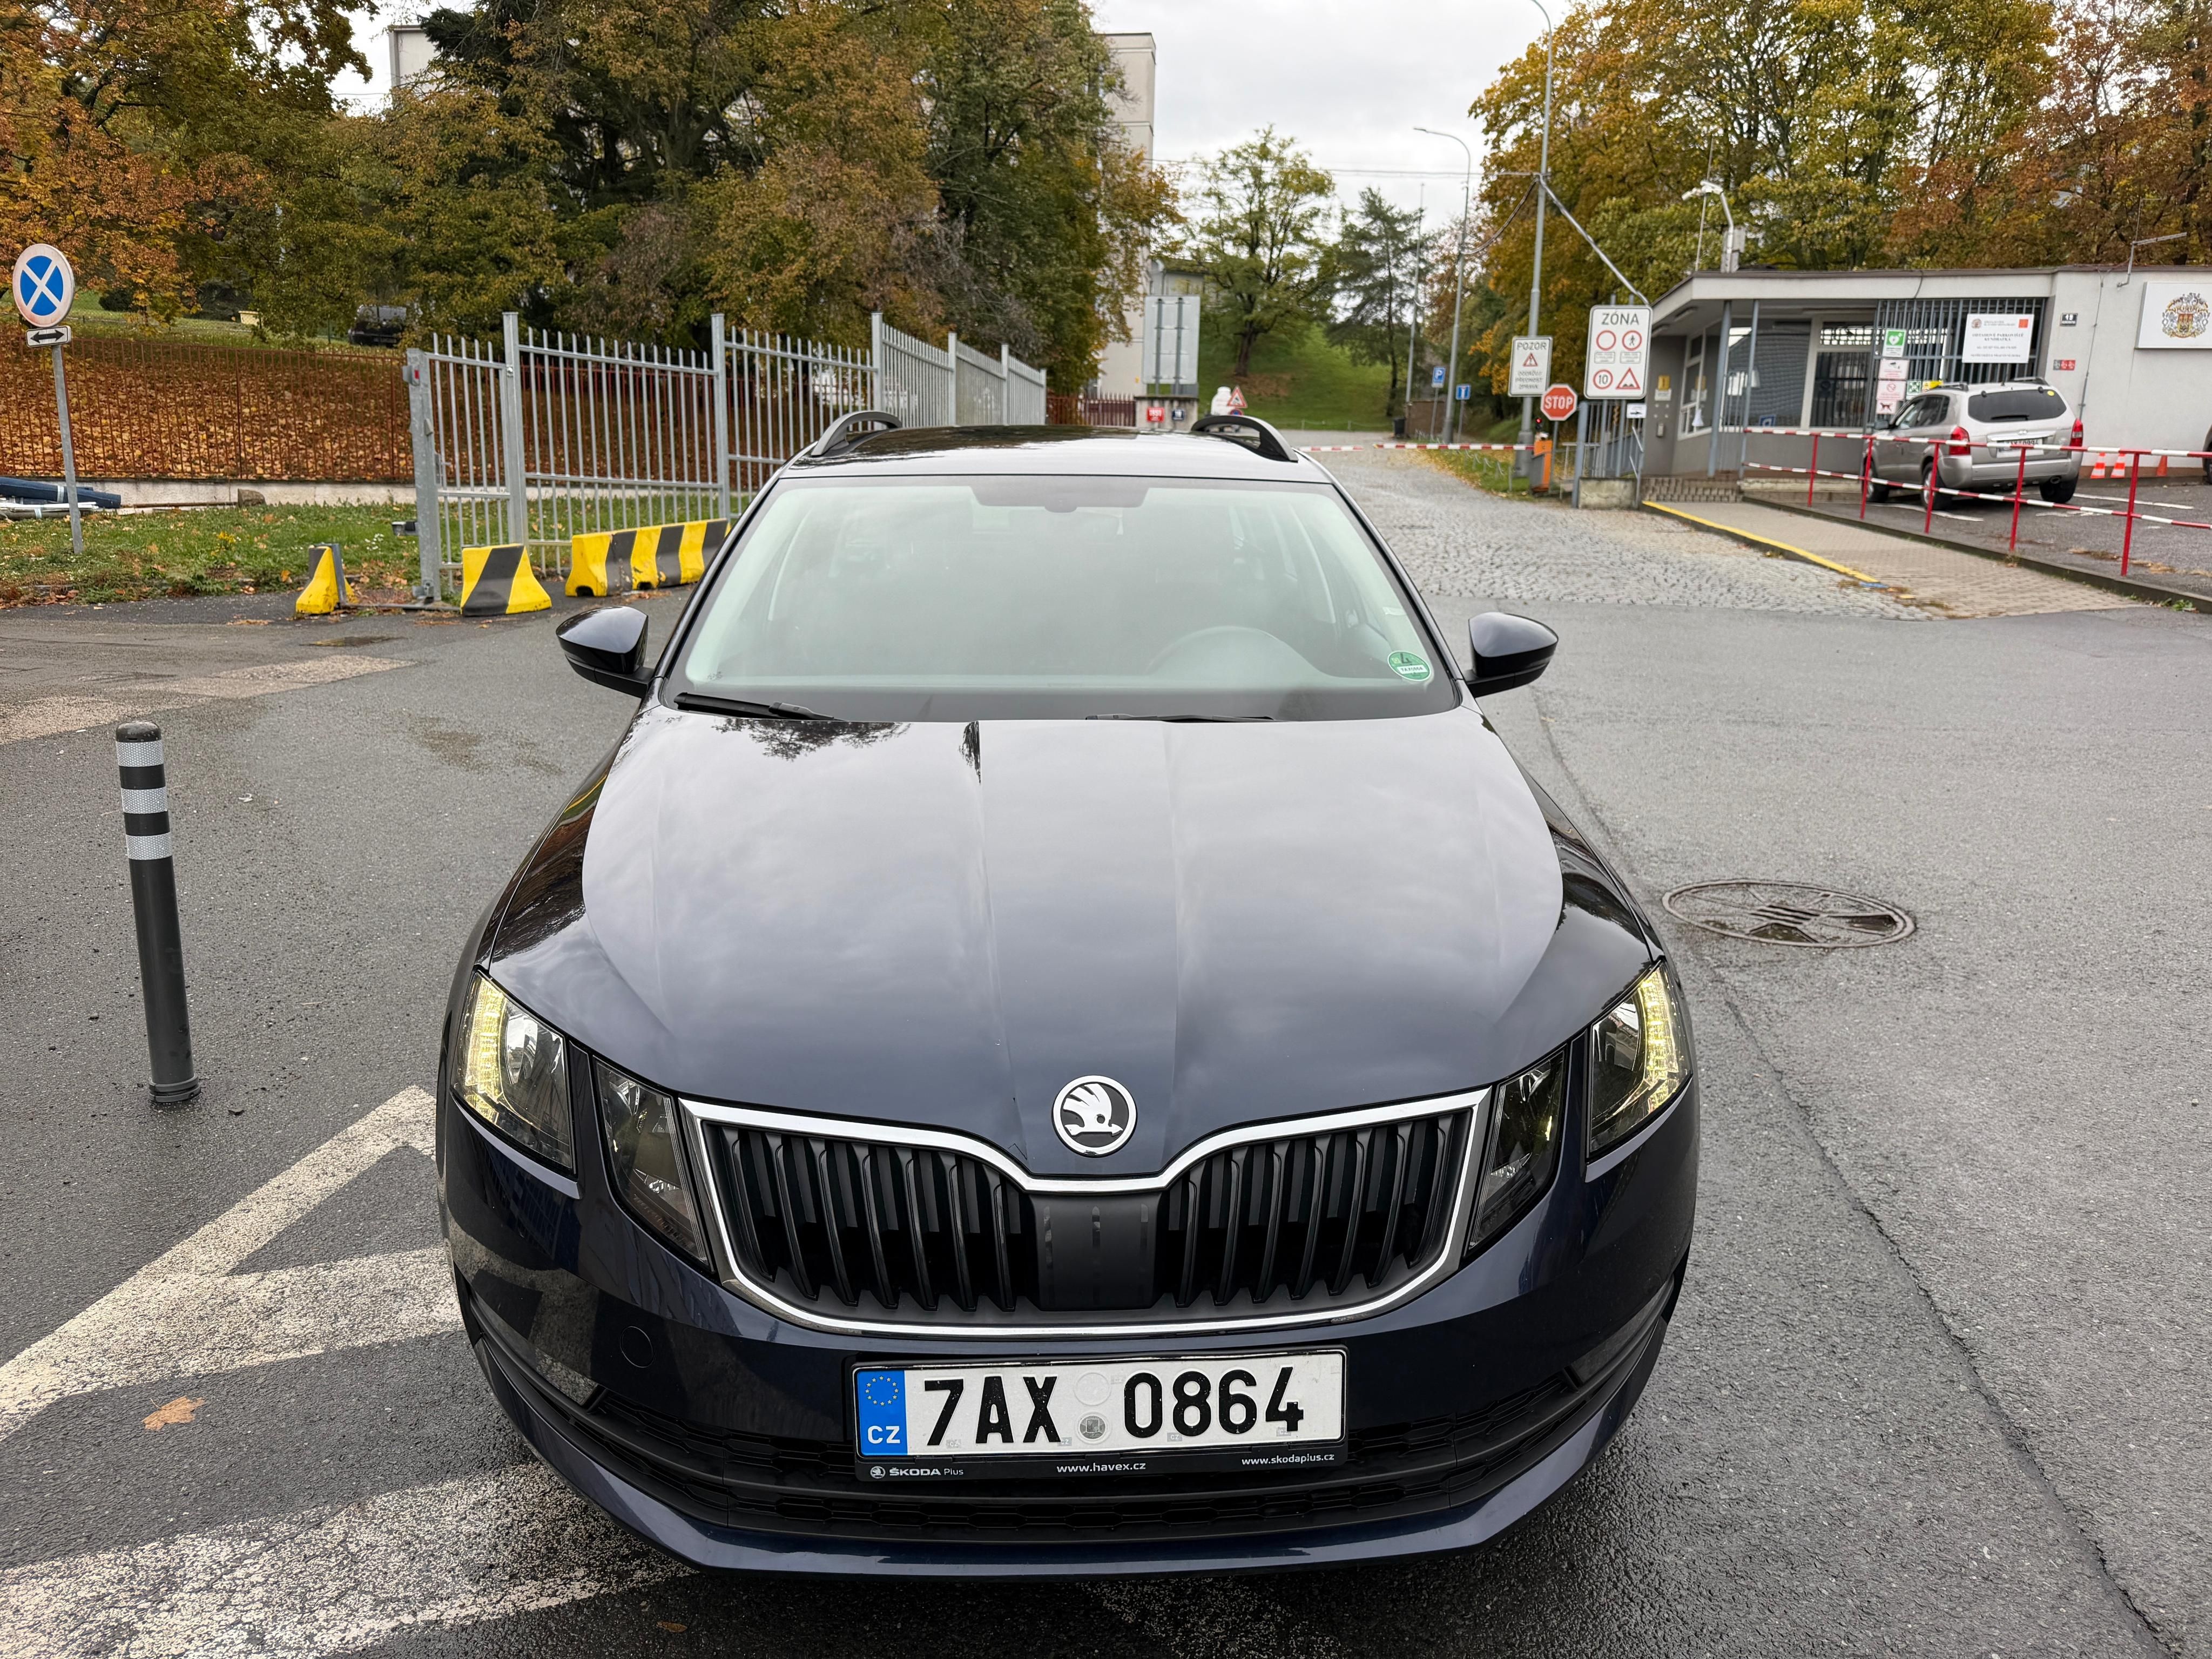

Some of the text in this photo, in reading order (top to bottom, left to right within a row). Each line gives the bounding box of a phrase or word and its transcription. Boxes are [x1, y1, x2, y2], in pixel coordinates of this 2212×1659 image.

[1601, 311, 1640, 326] ZÓNA
[1516, 342, 1547, 350] POZOR
[1599, 374, 1608, 385] 10
[1545, 395, 1573, 409] STOP
[925, 1367, 1304, 1446] 7AX 0864
[867, 1426, 900, 1444] CZ
[1242, 1453, 1334, 1465] www.skodaplus.cz
[889, 1467, 941, 1476] ŠKODA
[1056, 1462, 1146, 1473] www.havex.cz
